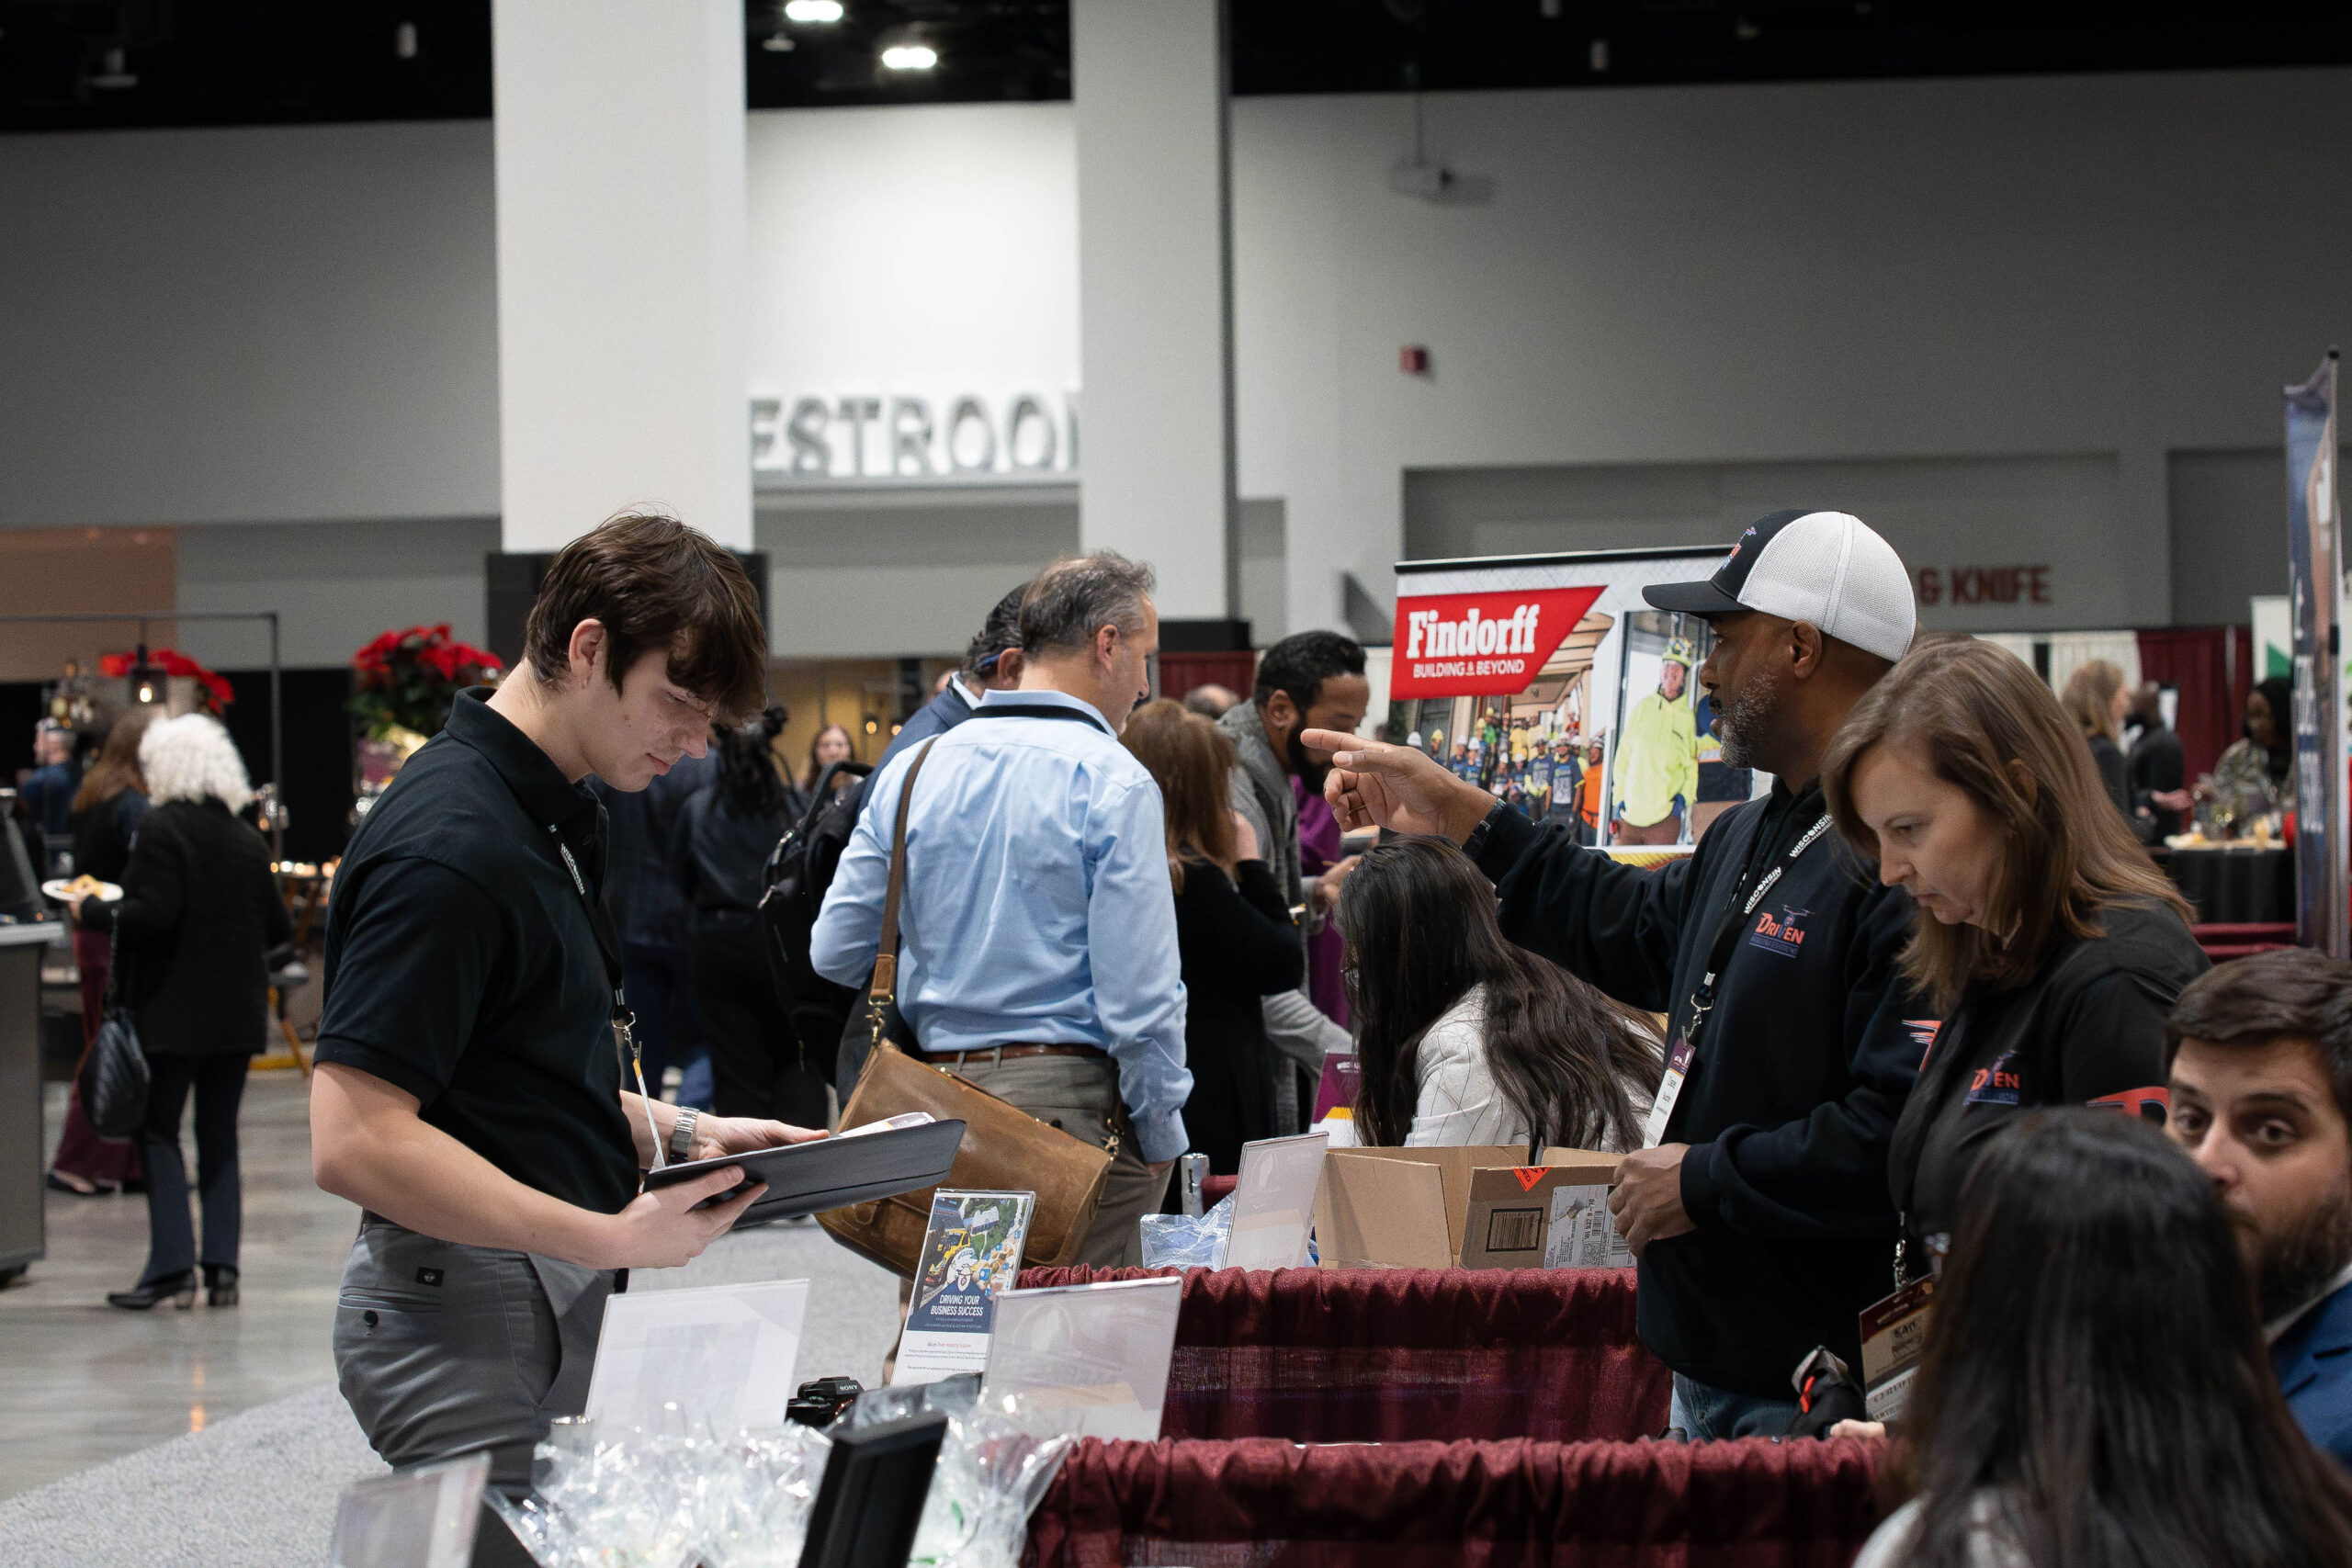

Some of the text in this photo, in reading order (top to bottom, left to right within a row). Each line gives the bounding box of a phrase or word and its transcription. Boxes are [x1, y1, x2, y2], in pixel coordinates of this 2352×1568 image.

[749, 395, 1080, 474] ESTROO
[1950, 565, 2051, 604] KNIFE
[1406, 604, 1541, 659] Findorff
[1413, 661, 1465, 679] BUILDING
[1476, 659, 1525, 675] BEYOND
[930, 1305, 984, 1316] BUSINESS SUCCESS
[939, 1294, 980, 1305] DRIVING YOUR
